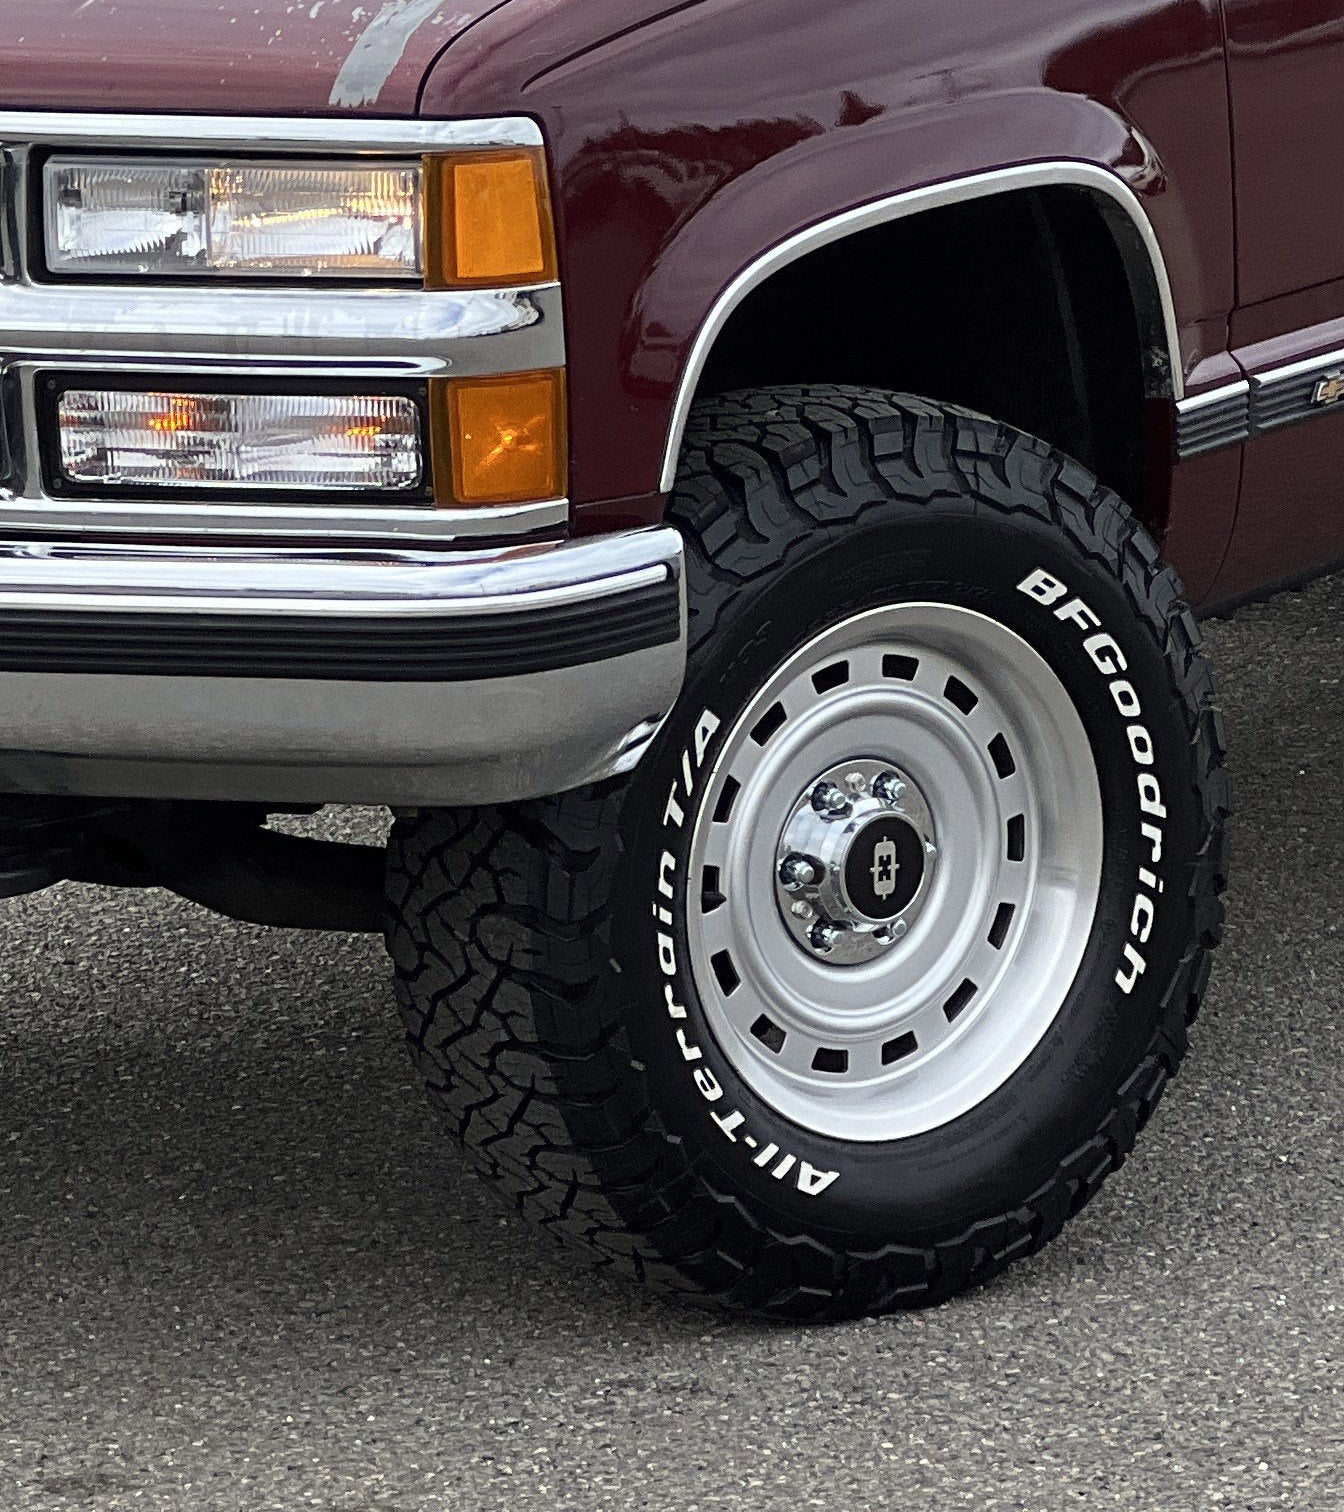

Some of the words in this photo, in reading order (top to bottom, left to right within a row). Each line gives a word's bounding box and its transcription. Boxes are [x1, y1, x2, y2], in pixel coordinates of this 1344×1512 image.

[663, 707, 721, 827] T/A
[1016, 567, 1167, 994] BFGoodrich
[652, 849, 840, 1196] All-Terrain
